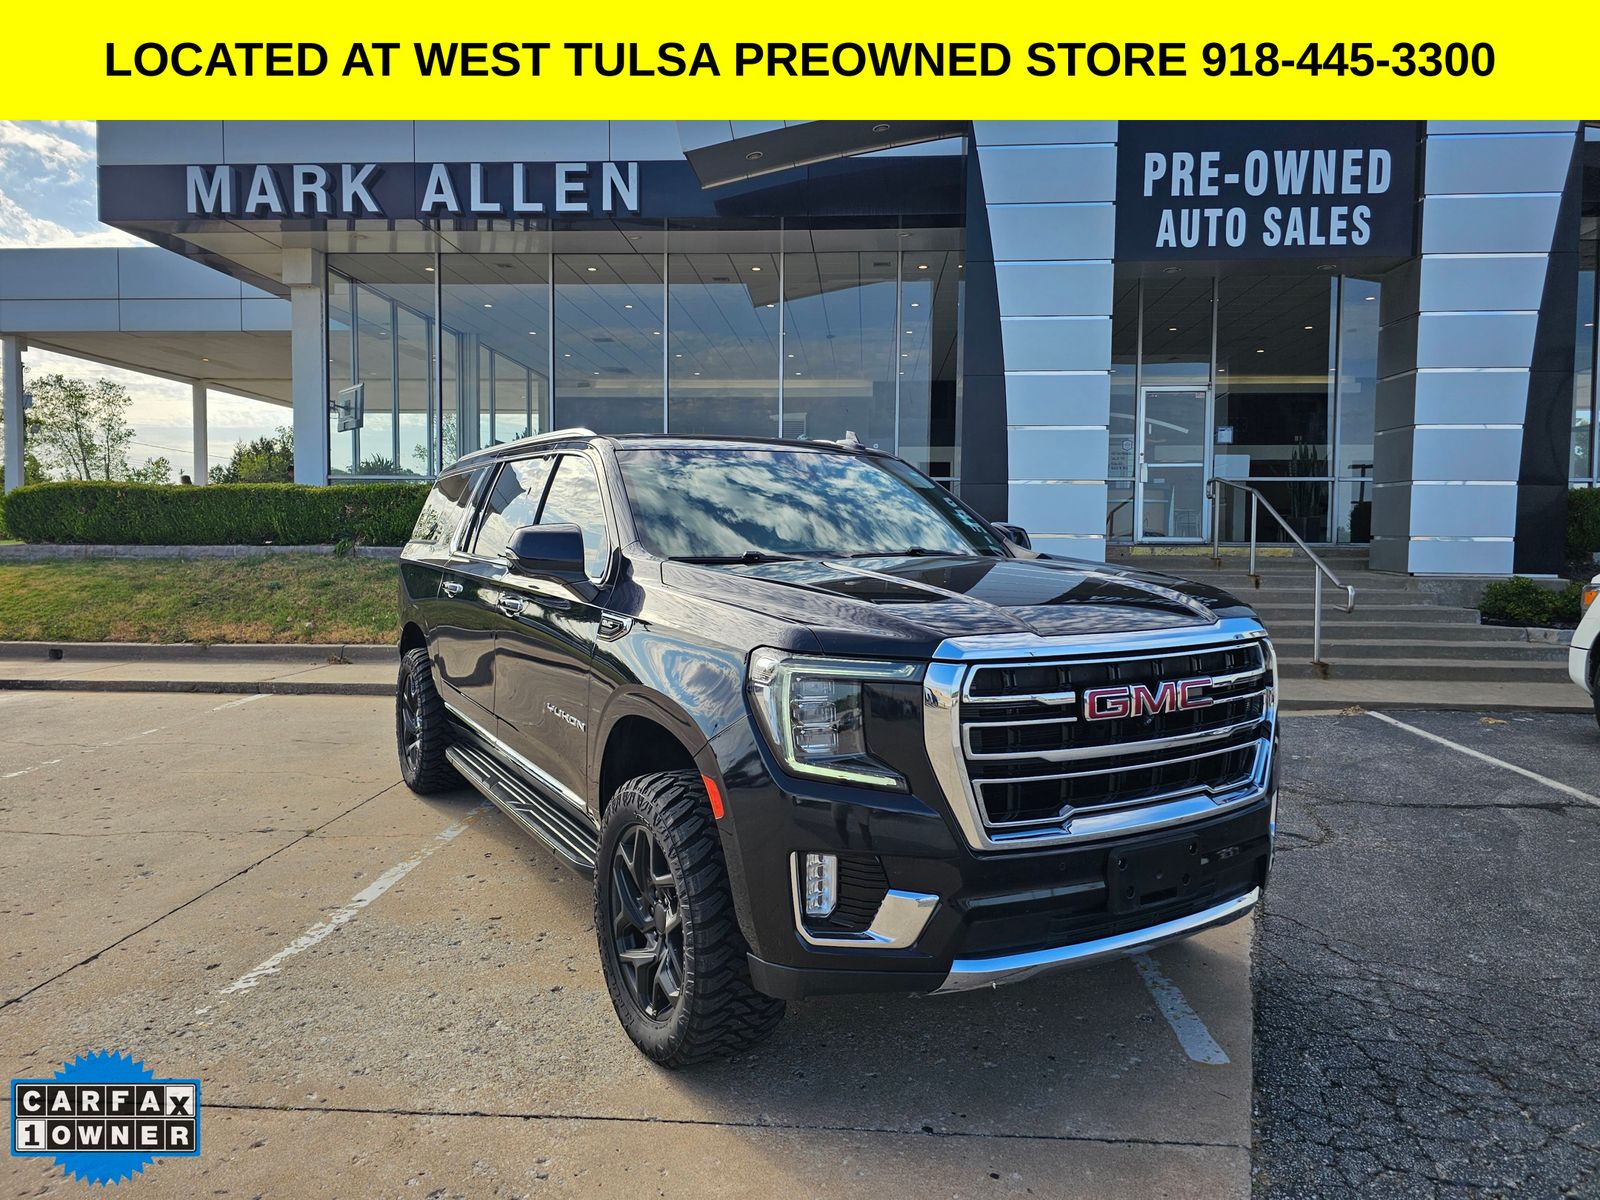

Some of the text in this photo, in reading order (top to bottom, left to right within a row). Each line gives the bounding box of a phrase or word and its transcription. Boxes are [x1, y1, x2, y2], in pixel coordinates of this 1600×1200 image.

[186, 161, 641, 215] MARK ALLEN
[1143, 148, 1392, 197] PRE-OWNED
[1155, 205, 1371, 248] AUTO SALES
[546, 702, 586, 732] YUKON
[1083, 677, 1214, 721] GMC
